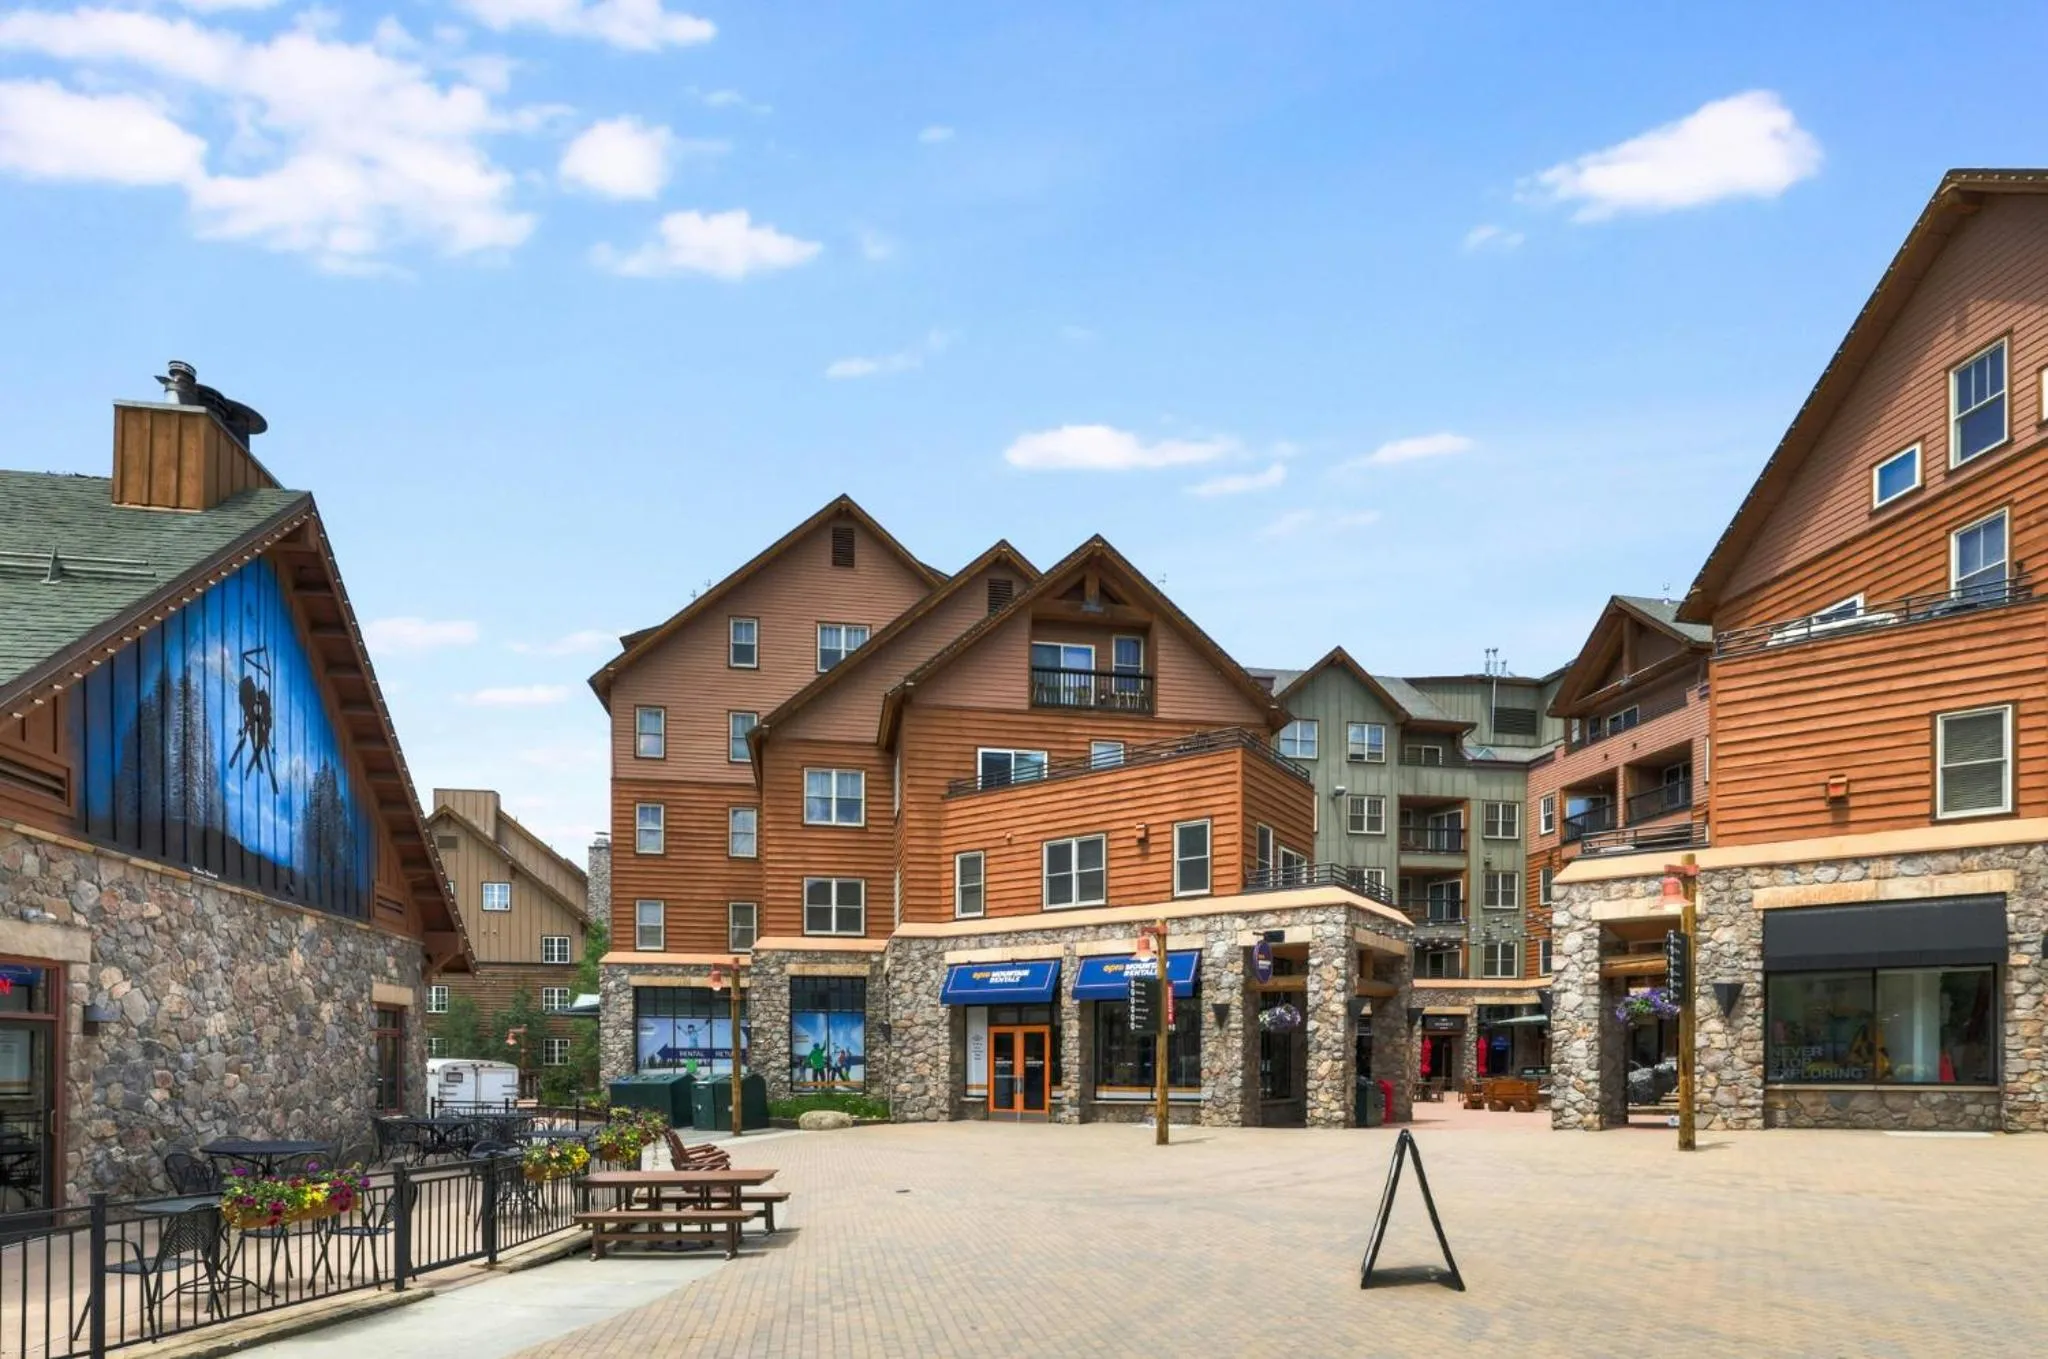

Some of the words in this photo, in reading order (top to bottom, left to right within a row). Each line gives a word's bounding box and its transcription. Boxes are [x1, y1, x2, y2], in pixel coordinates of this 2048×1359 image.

[1769, 1046, 1824, 1057] NEVER
[1769, 1058, 1813, 1069] STOP
[1769, 1068, 1865, 1080] EXPLORING
